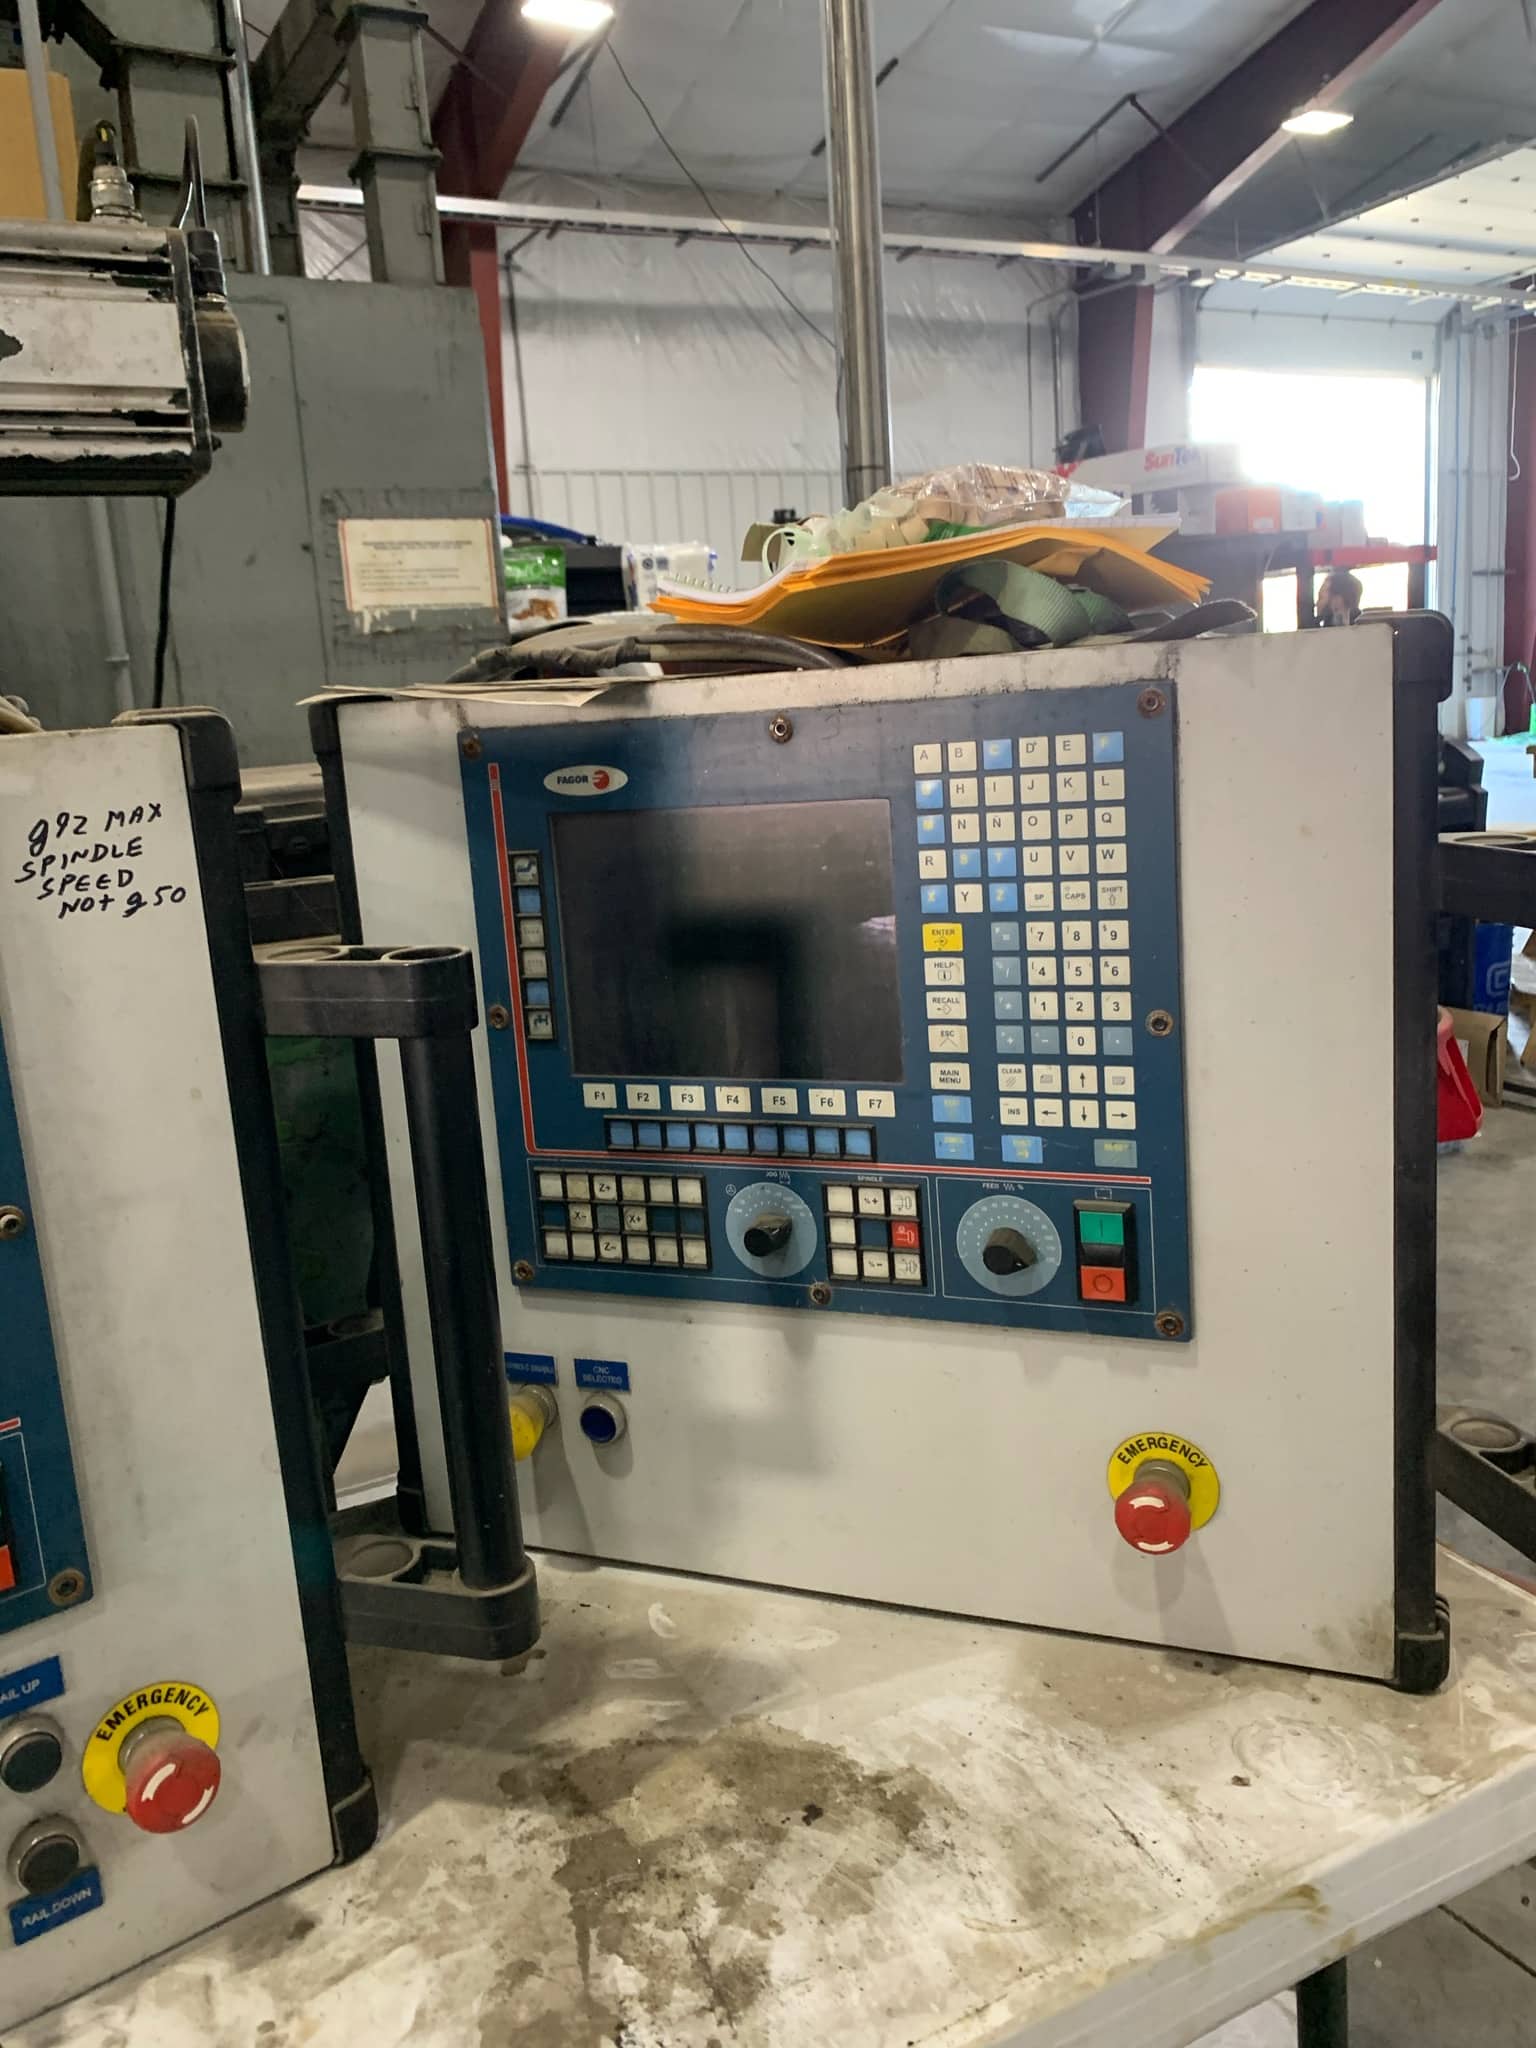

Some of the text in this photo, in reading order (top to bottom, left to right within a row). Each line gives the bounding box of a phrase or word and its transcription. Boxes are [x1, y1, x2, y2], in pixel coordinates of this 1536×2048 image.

[557, 775, 589, 785] FAGOR
[104, 803, 162, 832] MAX
[14, 836, 143, 883] SPINDLE
[37, 869, 134, 900] SPEED
[931, 928, 956, 936] ENTER
[934, 961, 954, 969] HELP
[594, 1091, 606, 1101] F1
[637, 1092, 650, 1102] F2
[681, 1093, 694, 1103] F3
[726, 1095, 739, 1104] F4
[772, 1095, 786, 1106] F5
[820, 1097, 834, 1108] F6
[869, 1098, 882, 1109] F7
[1117, 1436, 1208, 1468] EMERGENCY
[0, 1678, 40, 1704] AIL UP
[96, 1687, 210, 1742] EMERGENCY
[22, 1888, 91, 1928] RAIL DOWN
